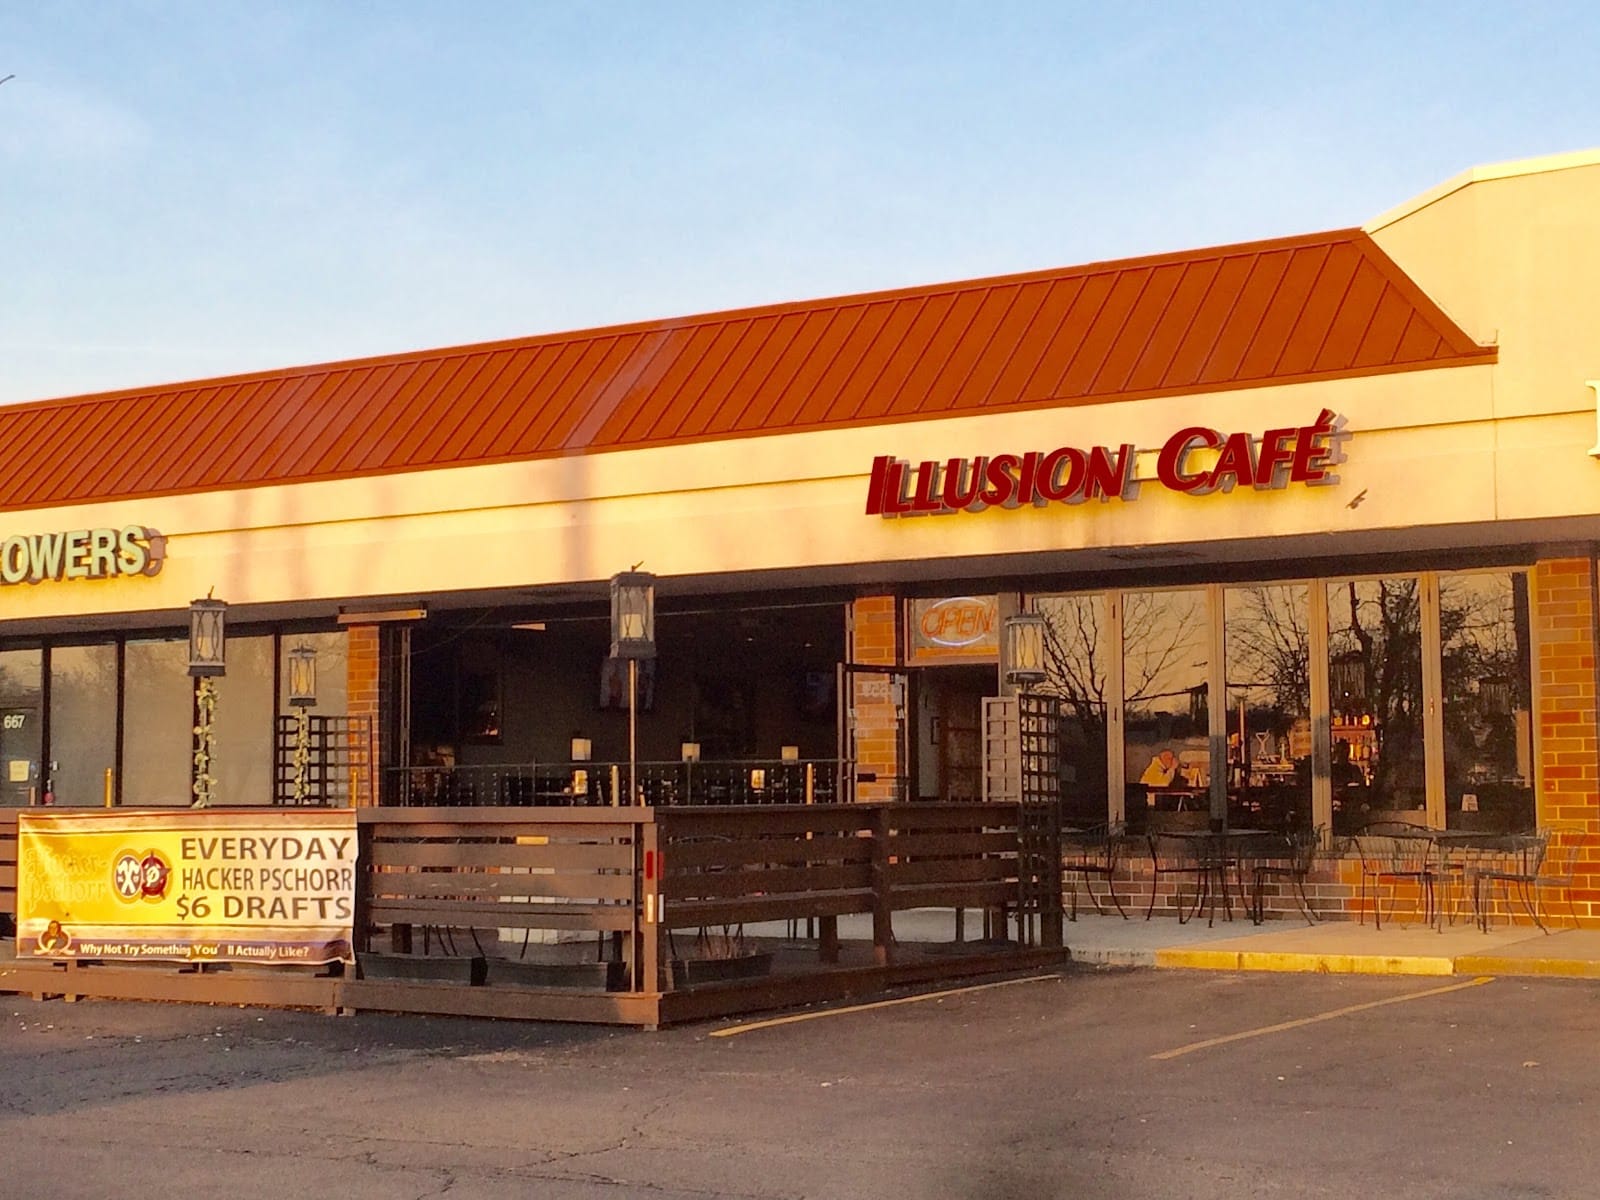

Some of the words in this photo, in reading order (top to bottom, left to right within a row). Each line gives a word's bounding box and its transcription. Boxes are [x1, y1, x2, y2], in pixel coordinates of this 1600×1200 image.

[866, 444, 1134, 515] ILLUSION
[1157, 408, 1337, 492] CAFÉ
[920, 606, 996, 638] OPEN
[3, 714, 25, 729] 667
[181, 837, 351, 860] EVERYDAY
[182, 868, 255, 892] HACKER
[260, 868, 353, 892] PSCHORR
[176, 896, 211, 921] $6
[223, 896, 352, 920] DRAFTS
[80, 943, 102, 957] Why
[104, 943, 121, 955] Not
[123, 943, 139, 957] Try
[141, 943, 191, 958] Something
[236, 945, 277, 959] Actually
[279, 946, 309, 958] Like?
